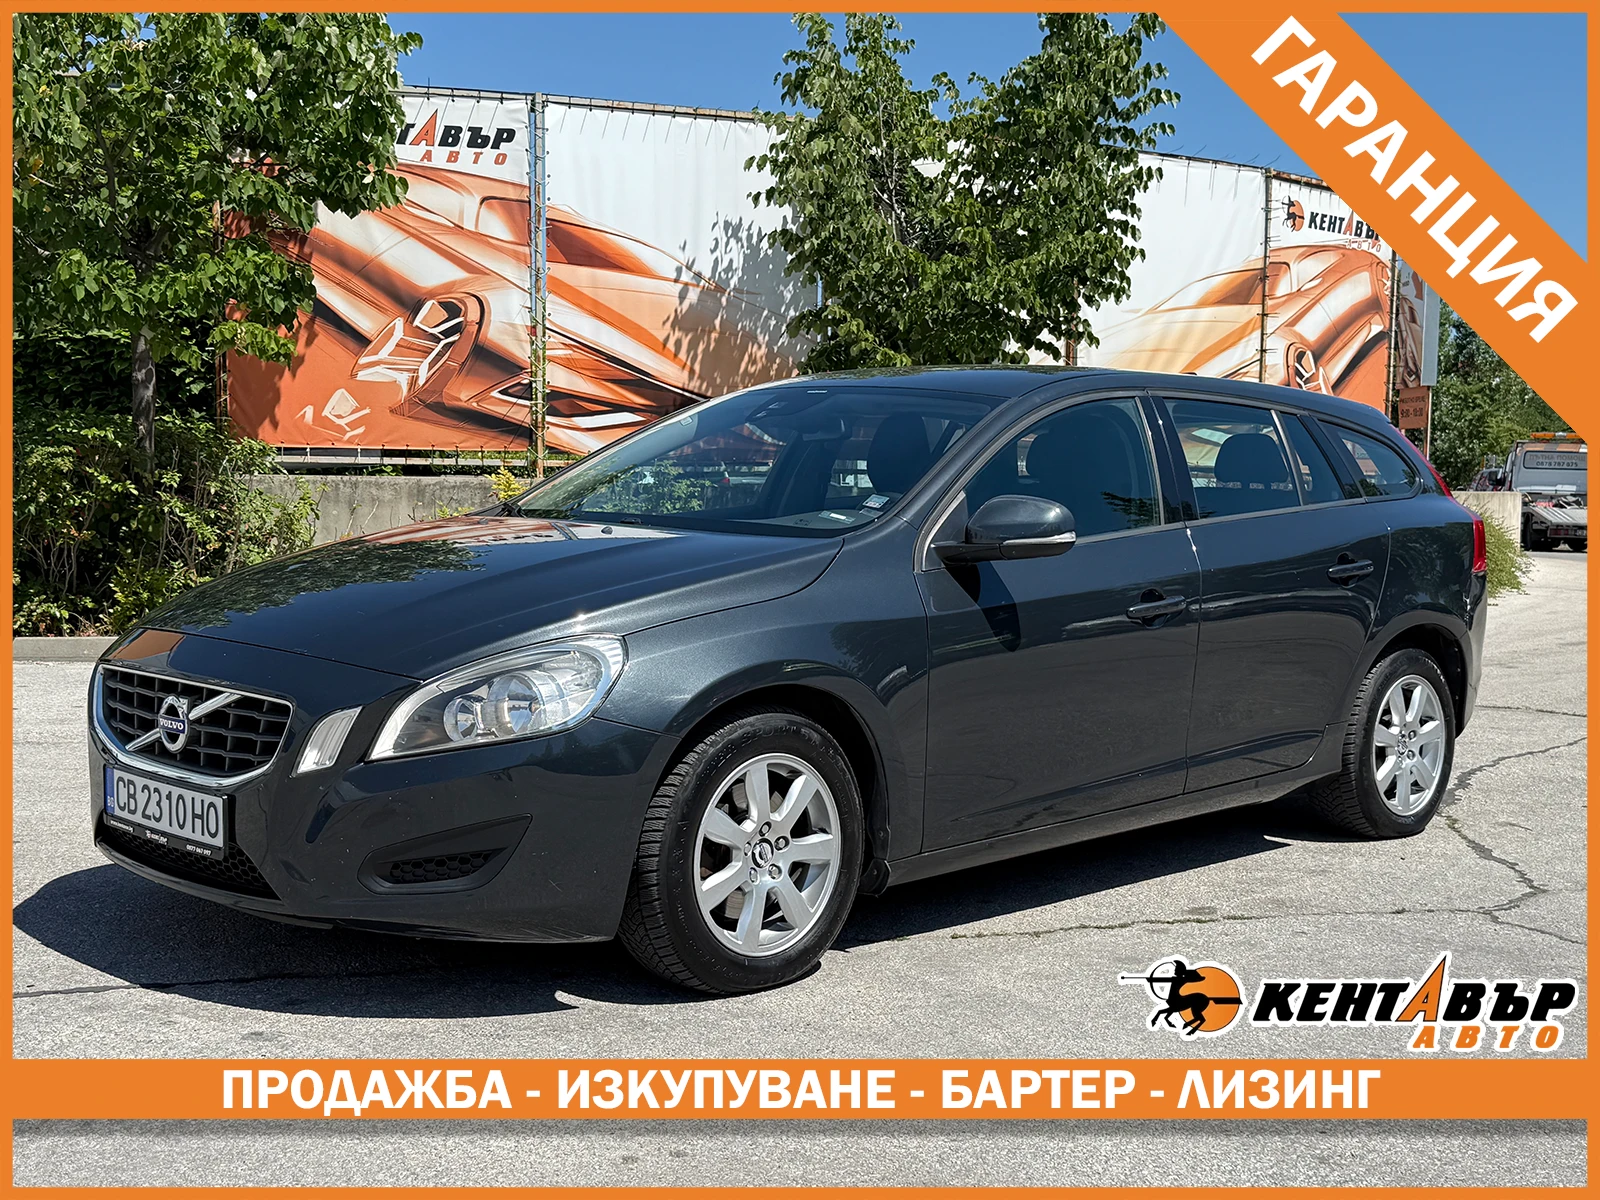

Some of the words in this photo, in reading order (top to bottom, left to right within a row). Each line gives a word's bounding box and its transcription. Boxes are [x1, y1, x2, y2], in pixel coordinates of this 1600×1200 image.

[395, 108, 516, 149] ТАВЪР
[420, 150, 508, 166] АВТО
[1346, 239, 1382, 253] АВТО
[160, 718, 184, 730] VOLVO
